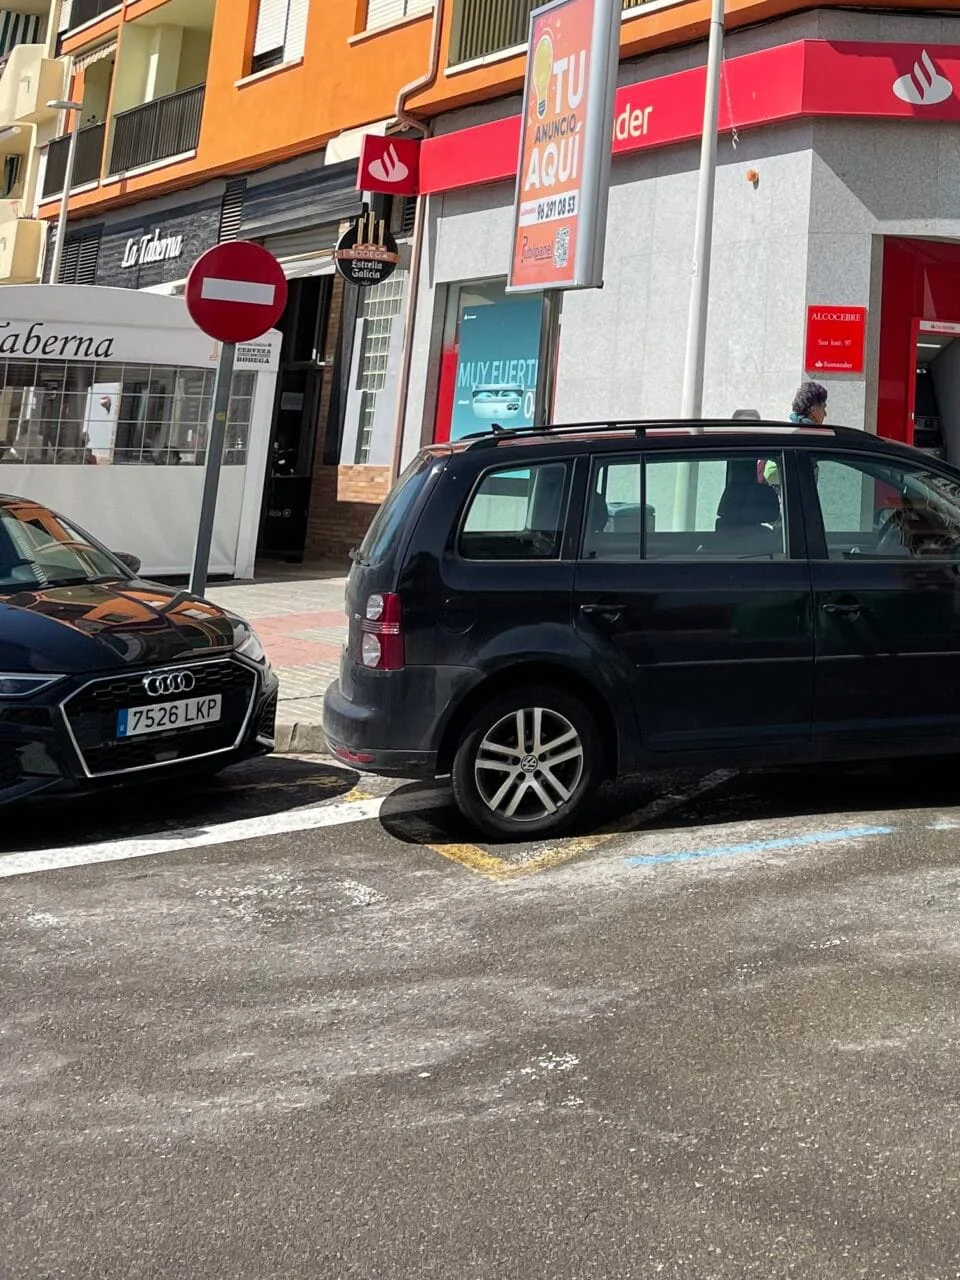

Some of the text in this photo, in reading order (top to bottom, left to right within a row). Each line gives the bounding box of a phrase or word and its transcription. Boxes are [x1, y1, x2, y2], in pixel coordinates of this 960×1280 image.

[553, 49, 586, 114] TU
[535, 114, 577, 144] ANUNCIO
[524, 121, 582, 192] AQUÍ
[537, 203, 547, 220] 96
[545, 200, 557, 219] 291
[557, 198, 567, 216] 08
[567, 195, 576, 213] 53
[121, 228, 183, 267] La Taberna
[351, 259, 382, 270] Estrella
[351, 269, 381, 279] Galicia
[811, 312, 861, 321] ALCOCEBRE
[0, 322, 114, 358] aberna
[236, 356, 270, 364] BODEGA
[457, 361, 490, 387] MUY
[132, 698, 217, 731] 7526 LKP
